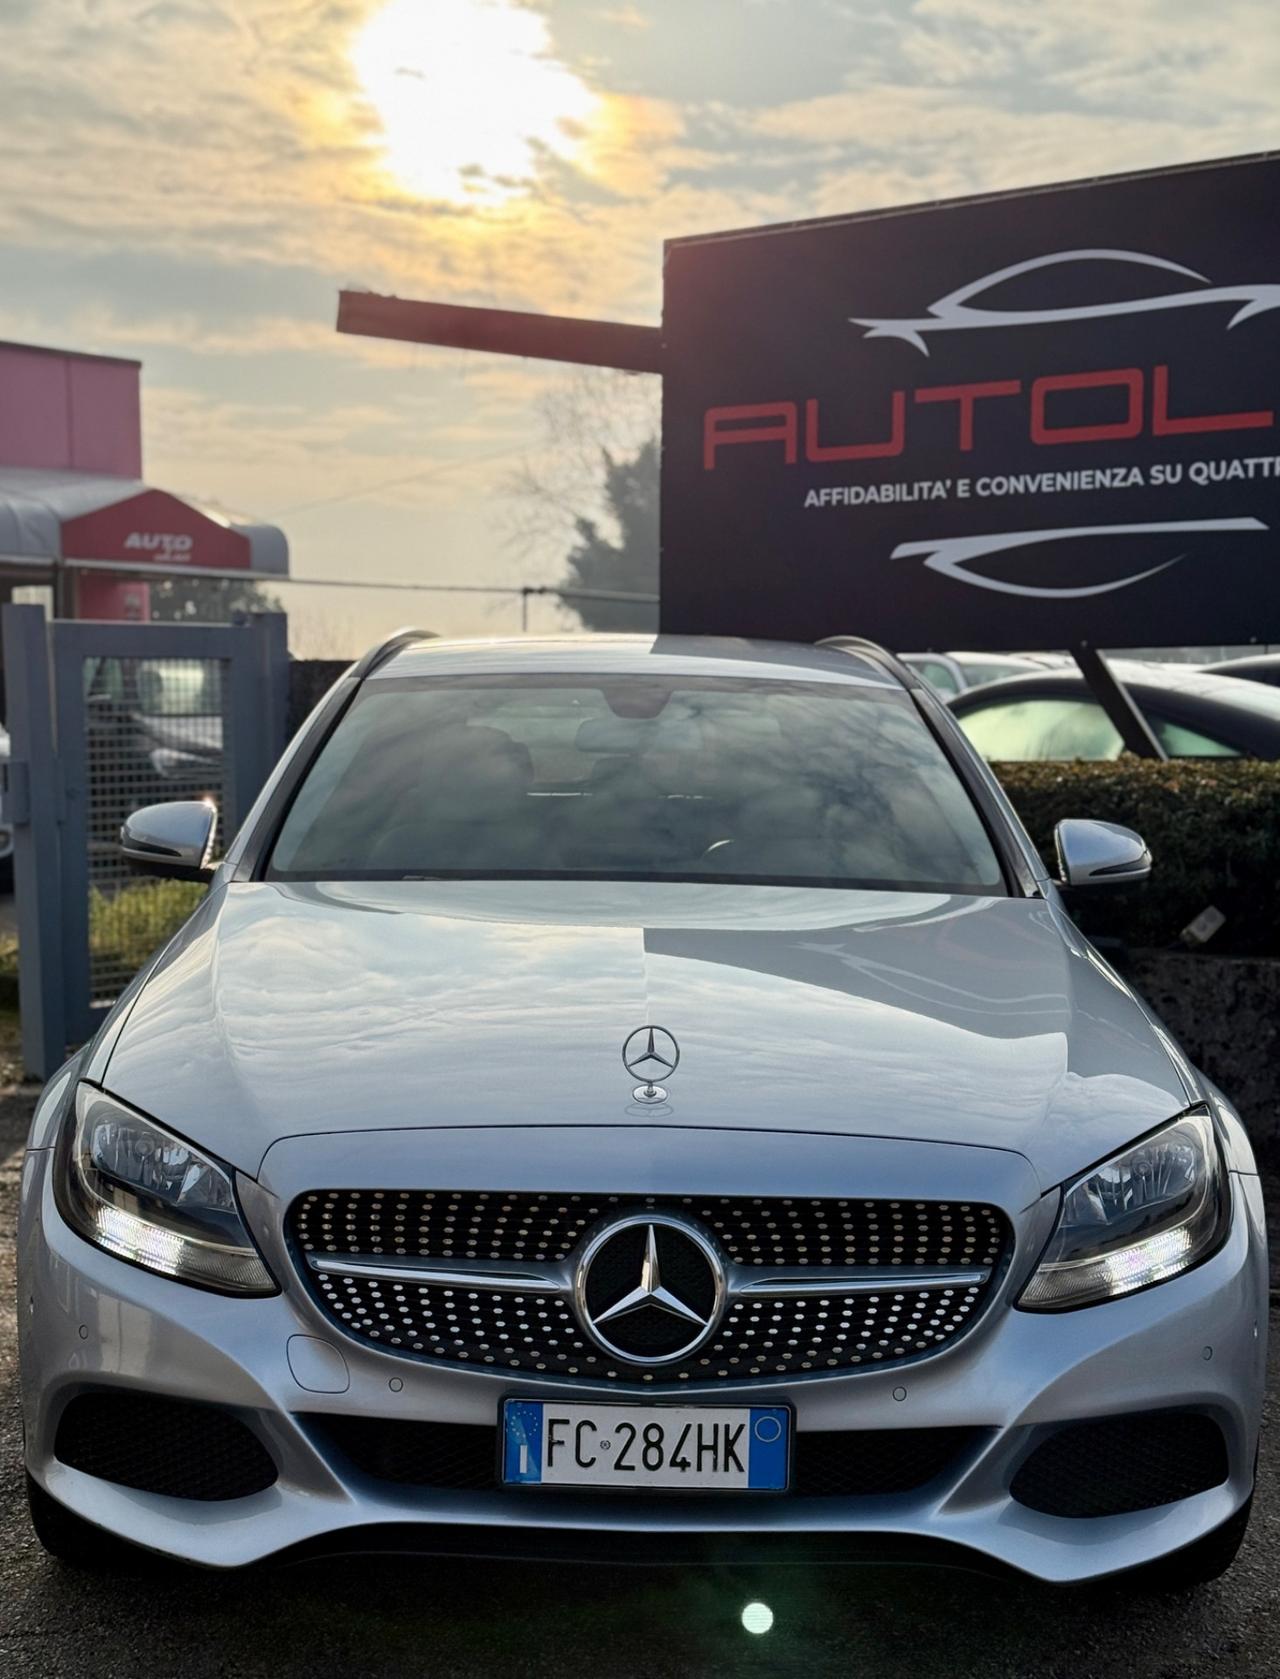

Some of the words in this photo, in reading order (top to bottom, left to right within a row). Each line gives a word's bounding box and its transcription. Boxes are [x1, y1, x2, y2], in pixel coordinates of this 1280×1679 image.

[703, 365, 1274, 470] AUTOL
[957, 478, 970, 498] E
[976, 466, 1144, 496] CONVENIENZA
[1150, 463, 1183, 485] SU
[124, 532, 193, 551] AUTO
